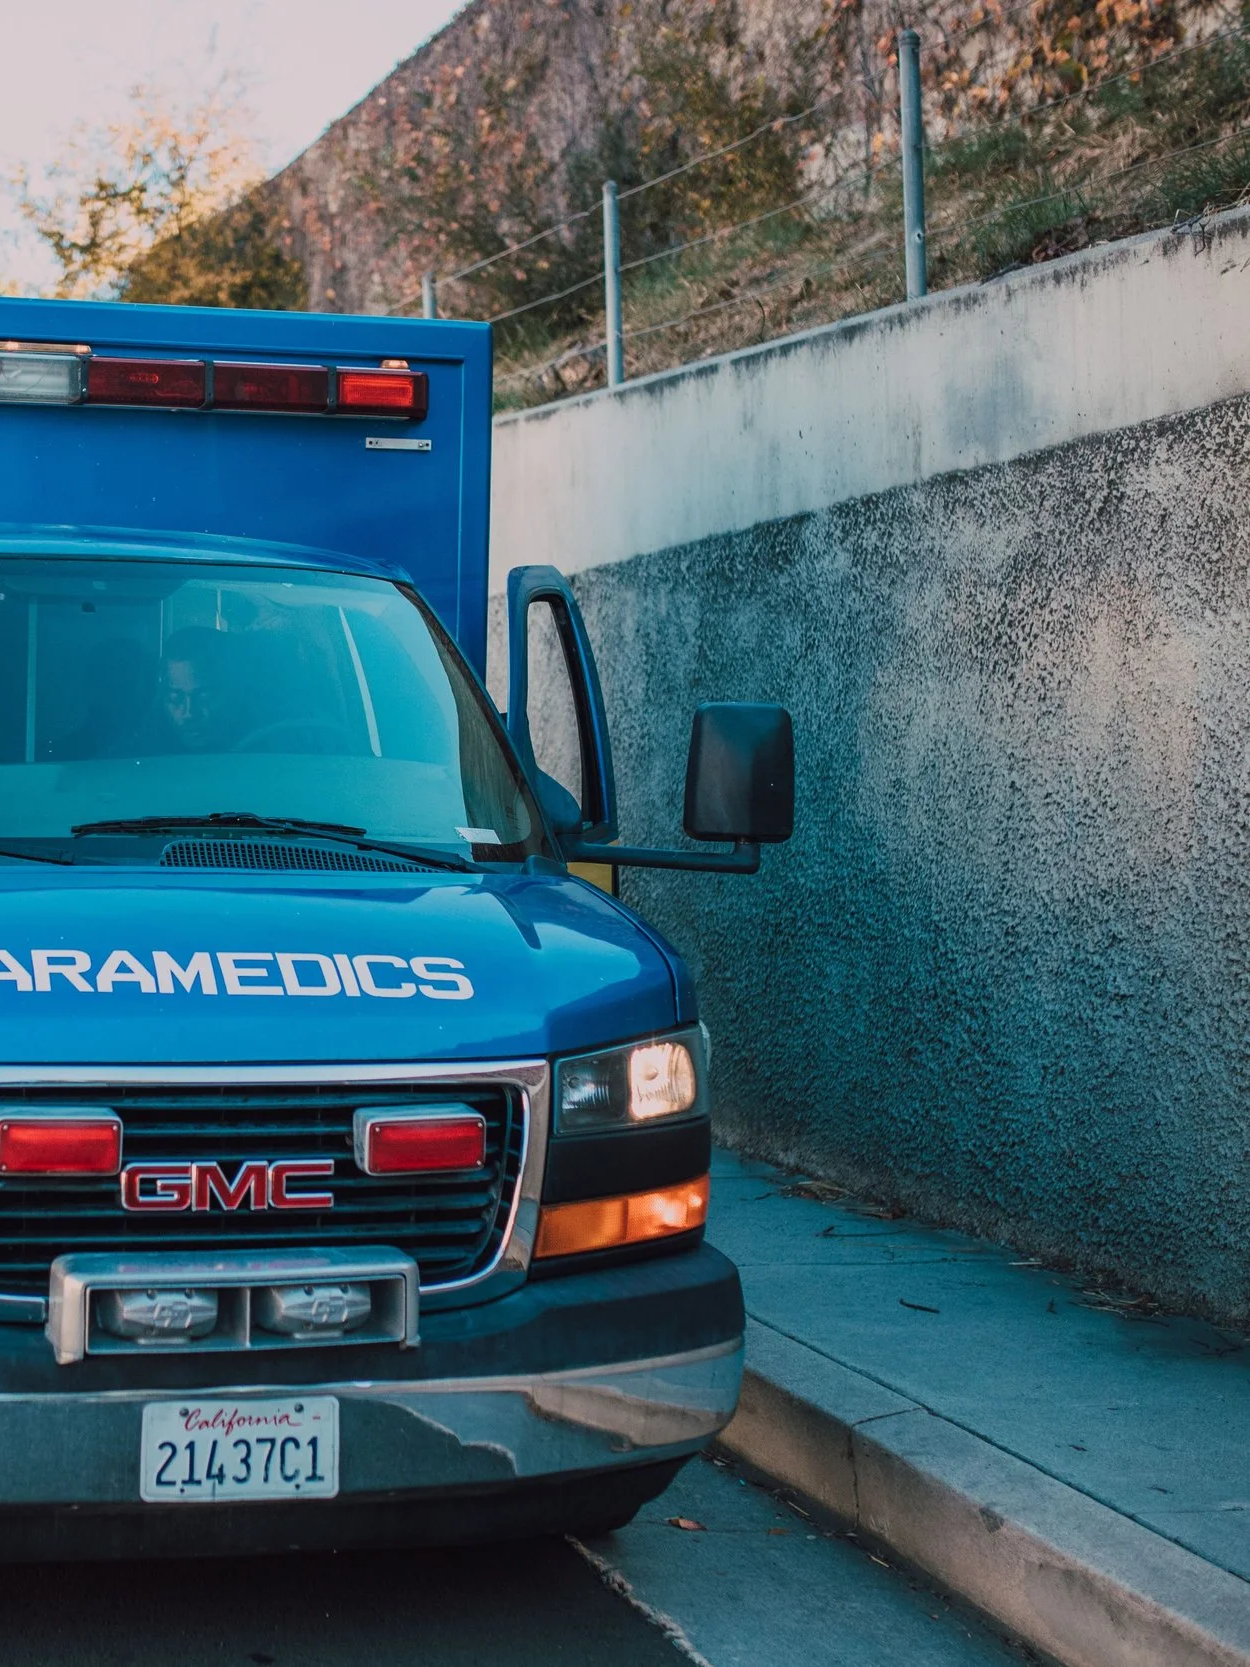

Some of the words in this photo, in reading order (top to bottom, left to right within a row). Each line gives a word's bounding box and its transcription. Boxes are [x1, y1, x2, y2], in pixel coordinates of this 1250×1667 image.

[121, 1159, 334, 1212] GMC
[183, 1408, 302, 1437] California
[155, 1436, 325, 1487] 21437C1
